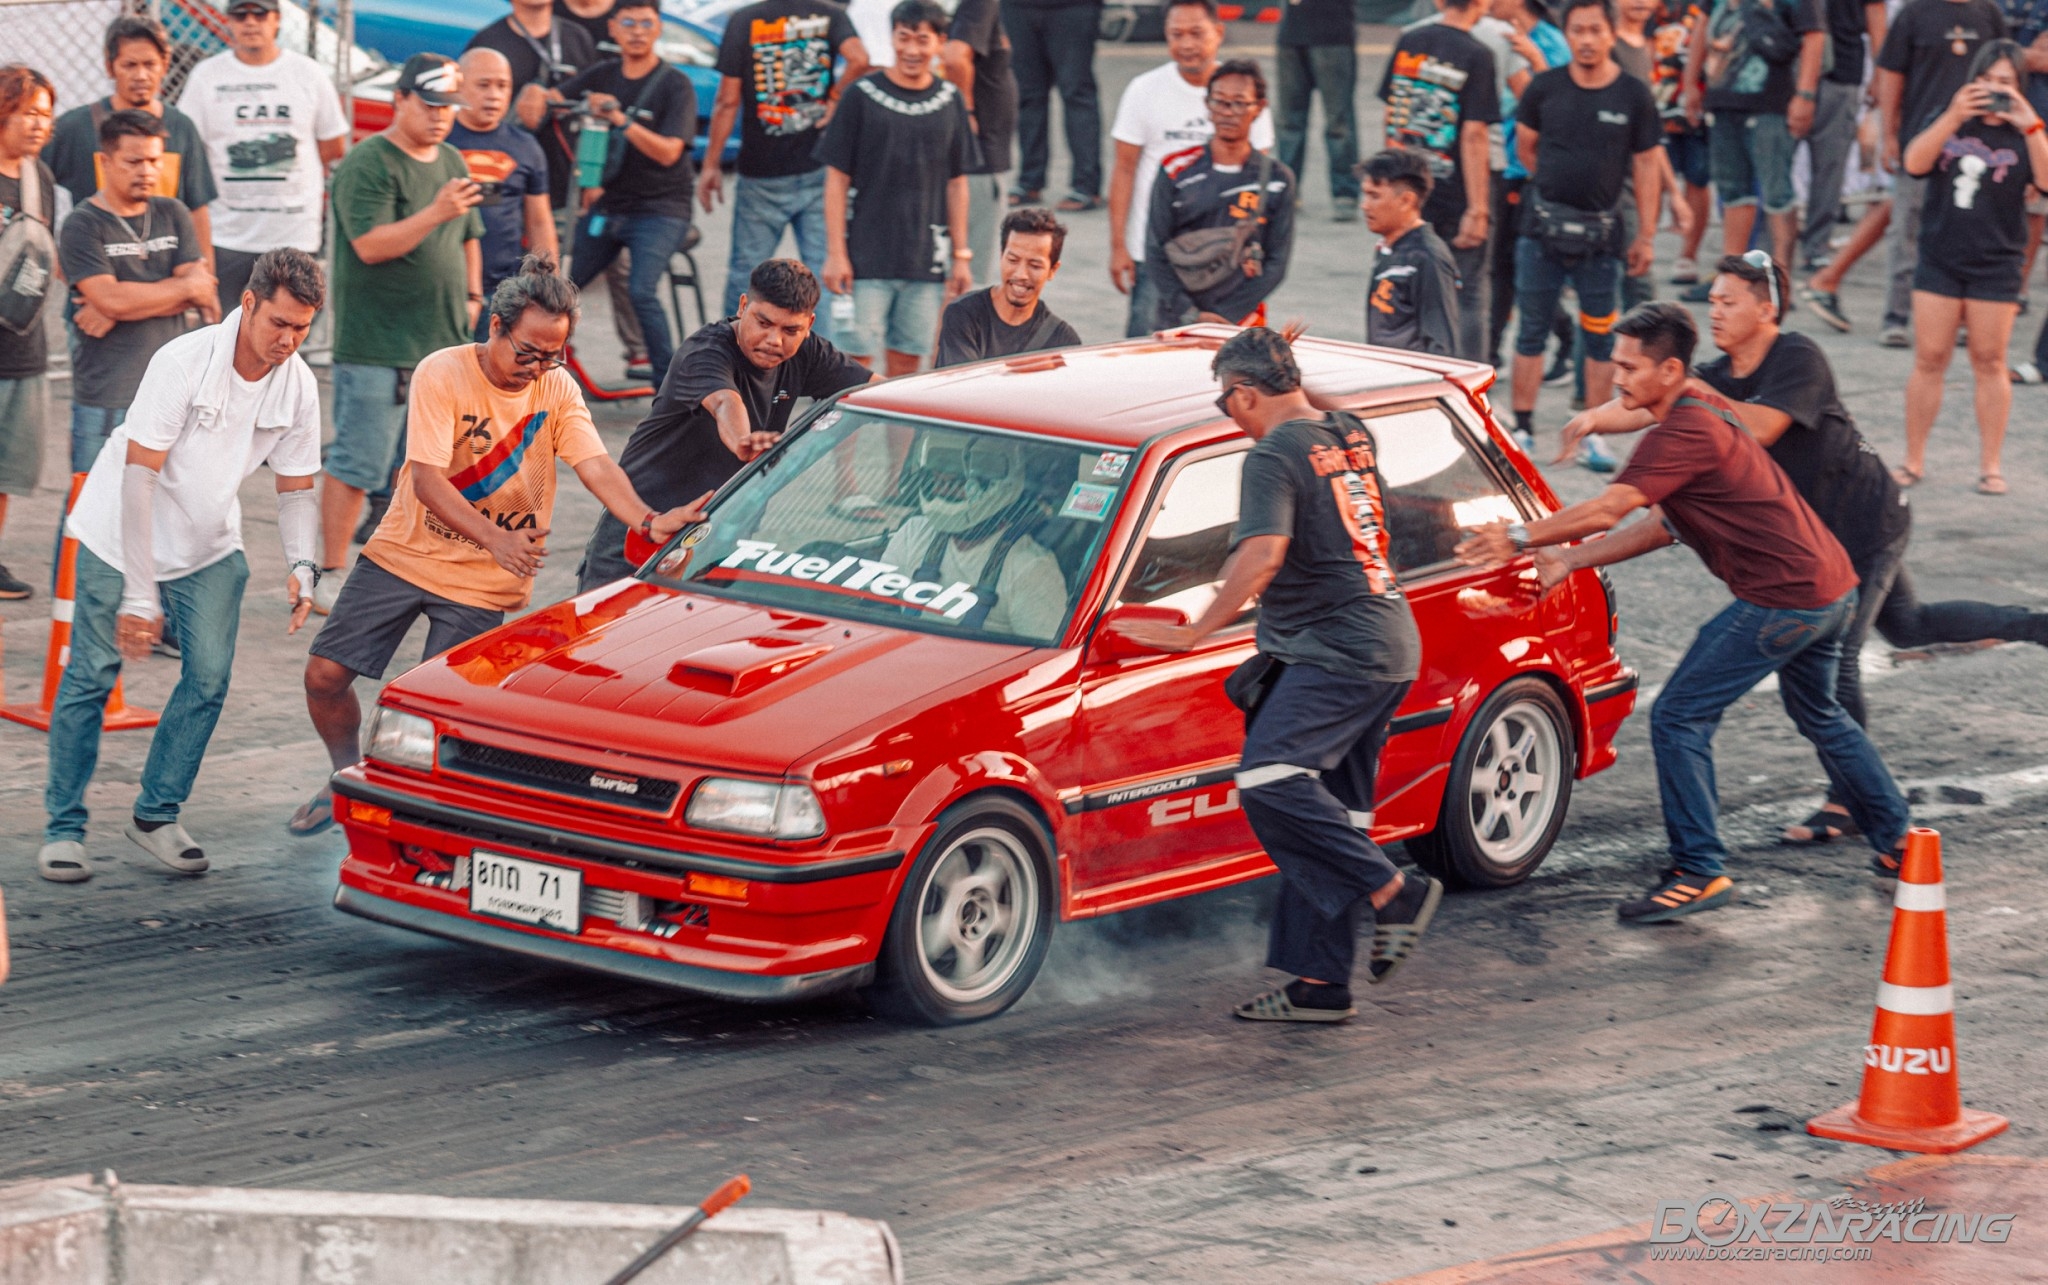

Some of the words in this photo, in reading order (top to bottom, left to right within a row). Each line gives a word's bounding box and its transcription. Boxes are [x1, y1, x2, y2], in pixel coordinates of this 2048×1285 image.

[236, 104, 291, 119] CAR
[453, 414, 492, 455] 76
[718, 539, 979, 619] FuelTech
[590, 774, 639, 795] turbo
[1107, 775, 1198, 804] INTERCOOLER
[538, 871, 561, 900] 71
[1863, 1044, 1952, 1075] SUZU
